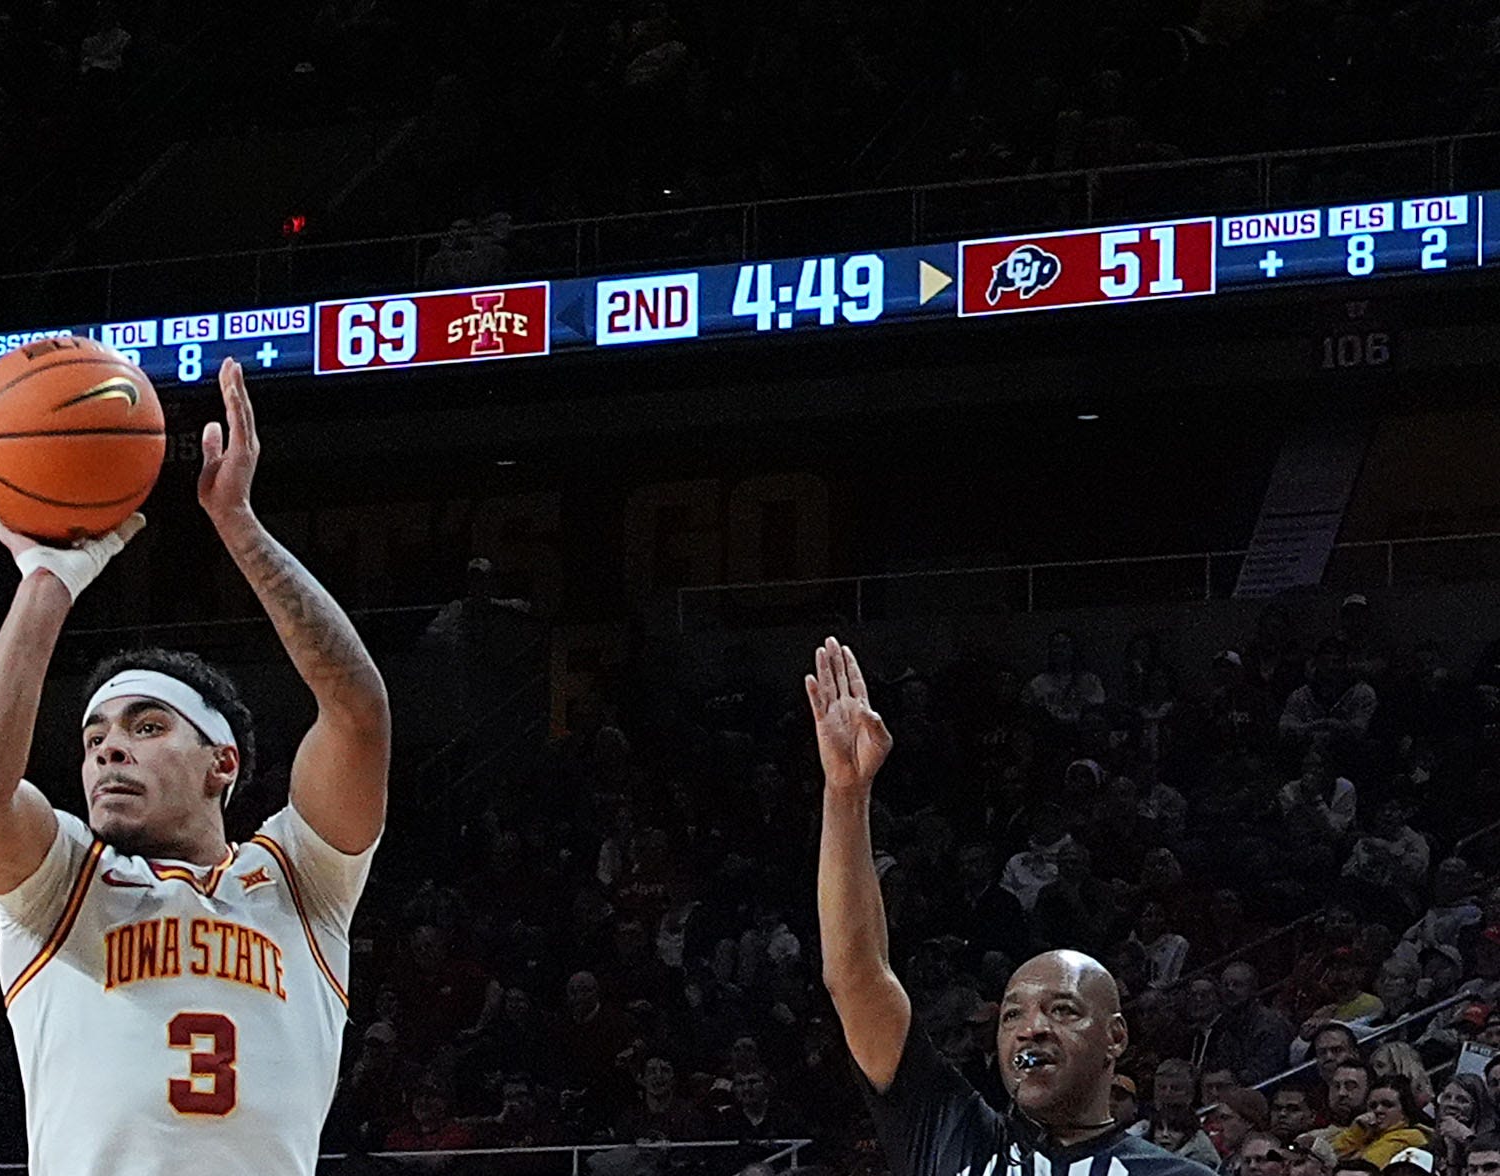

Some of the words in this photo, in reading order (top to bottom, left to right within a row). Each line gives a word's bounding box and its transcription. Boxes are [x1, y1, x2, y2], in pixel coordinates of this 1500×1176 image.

[1228, 213, 1316, 241] BONUS
[1340, 206, 1384, 231] FLS
[1410, 201, 1458, 224] TOL
[1100, 227, 1184, 298] 51
[1347, 233, 1375, 276] 8
[1420, 227, 1448, 270] 2
[607, 285, 689, 334] 2ND
[731, 253, 885, 331] 4:49
[110, 325, 149, 346] TOL
[173, 317, 211, 341] FLS
[229, 309, 306, 335] BONUS
[337, 299, 418, 367] 69
[447, 311, 529, 344] STATE
[177, 343, 203, 382] 8
[103, 916, 182, 992] IOWA
[189, 916, 287, 1003] STATE
[167, 1011, 238, 1117] 3
